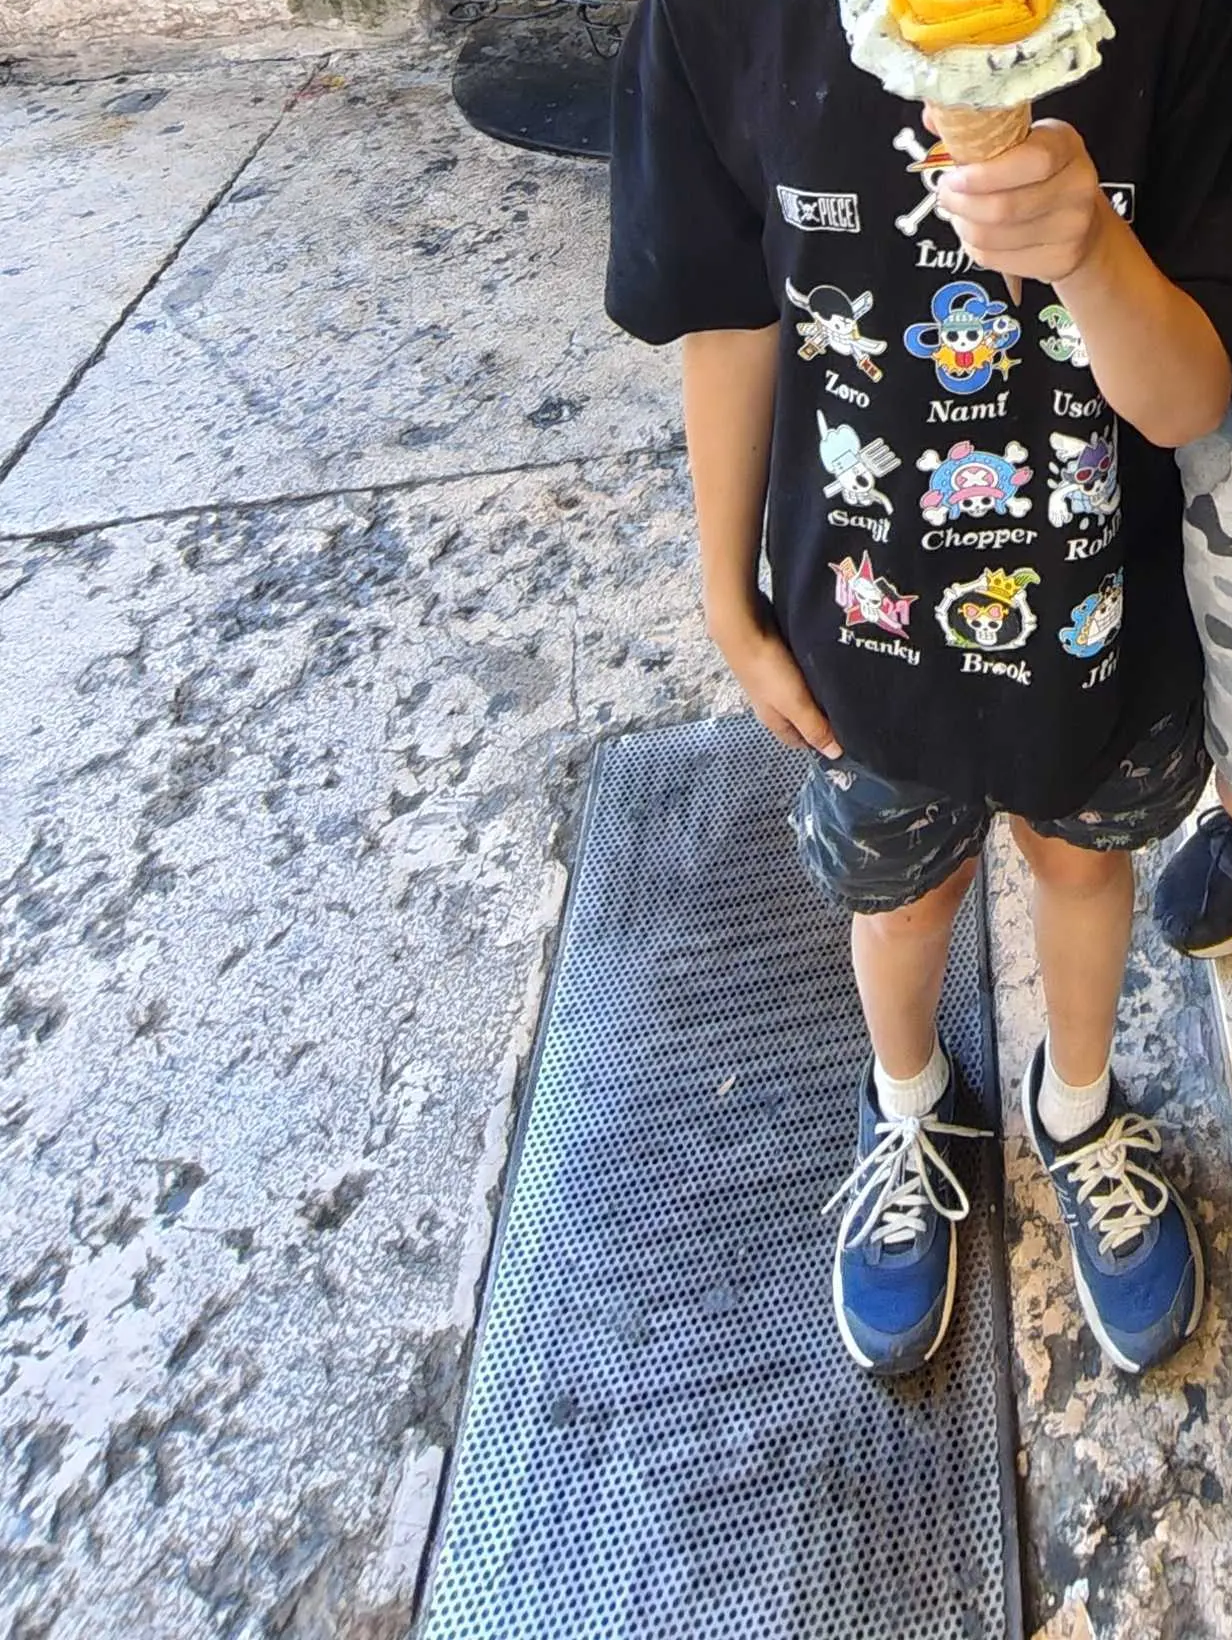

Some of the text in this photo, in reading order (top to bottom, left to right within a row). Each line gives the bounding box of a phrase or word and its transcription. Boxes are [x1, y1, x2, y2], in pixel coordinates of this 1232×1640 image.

[818, 197, 855, 228] PIECE
[825, 369, 871, 409] Zoro
[927, 391, 1010, 424] Nami
[827, 509, 891, 544] Sanji
[921, 525, 1037, 553] Chopper
[838, 626, 921, 666] Franky
[960, 653, 1032, 687] Brook
